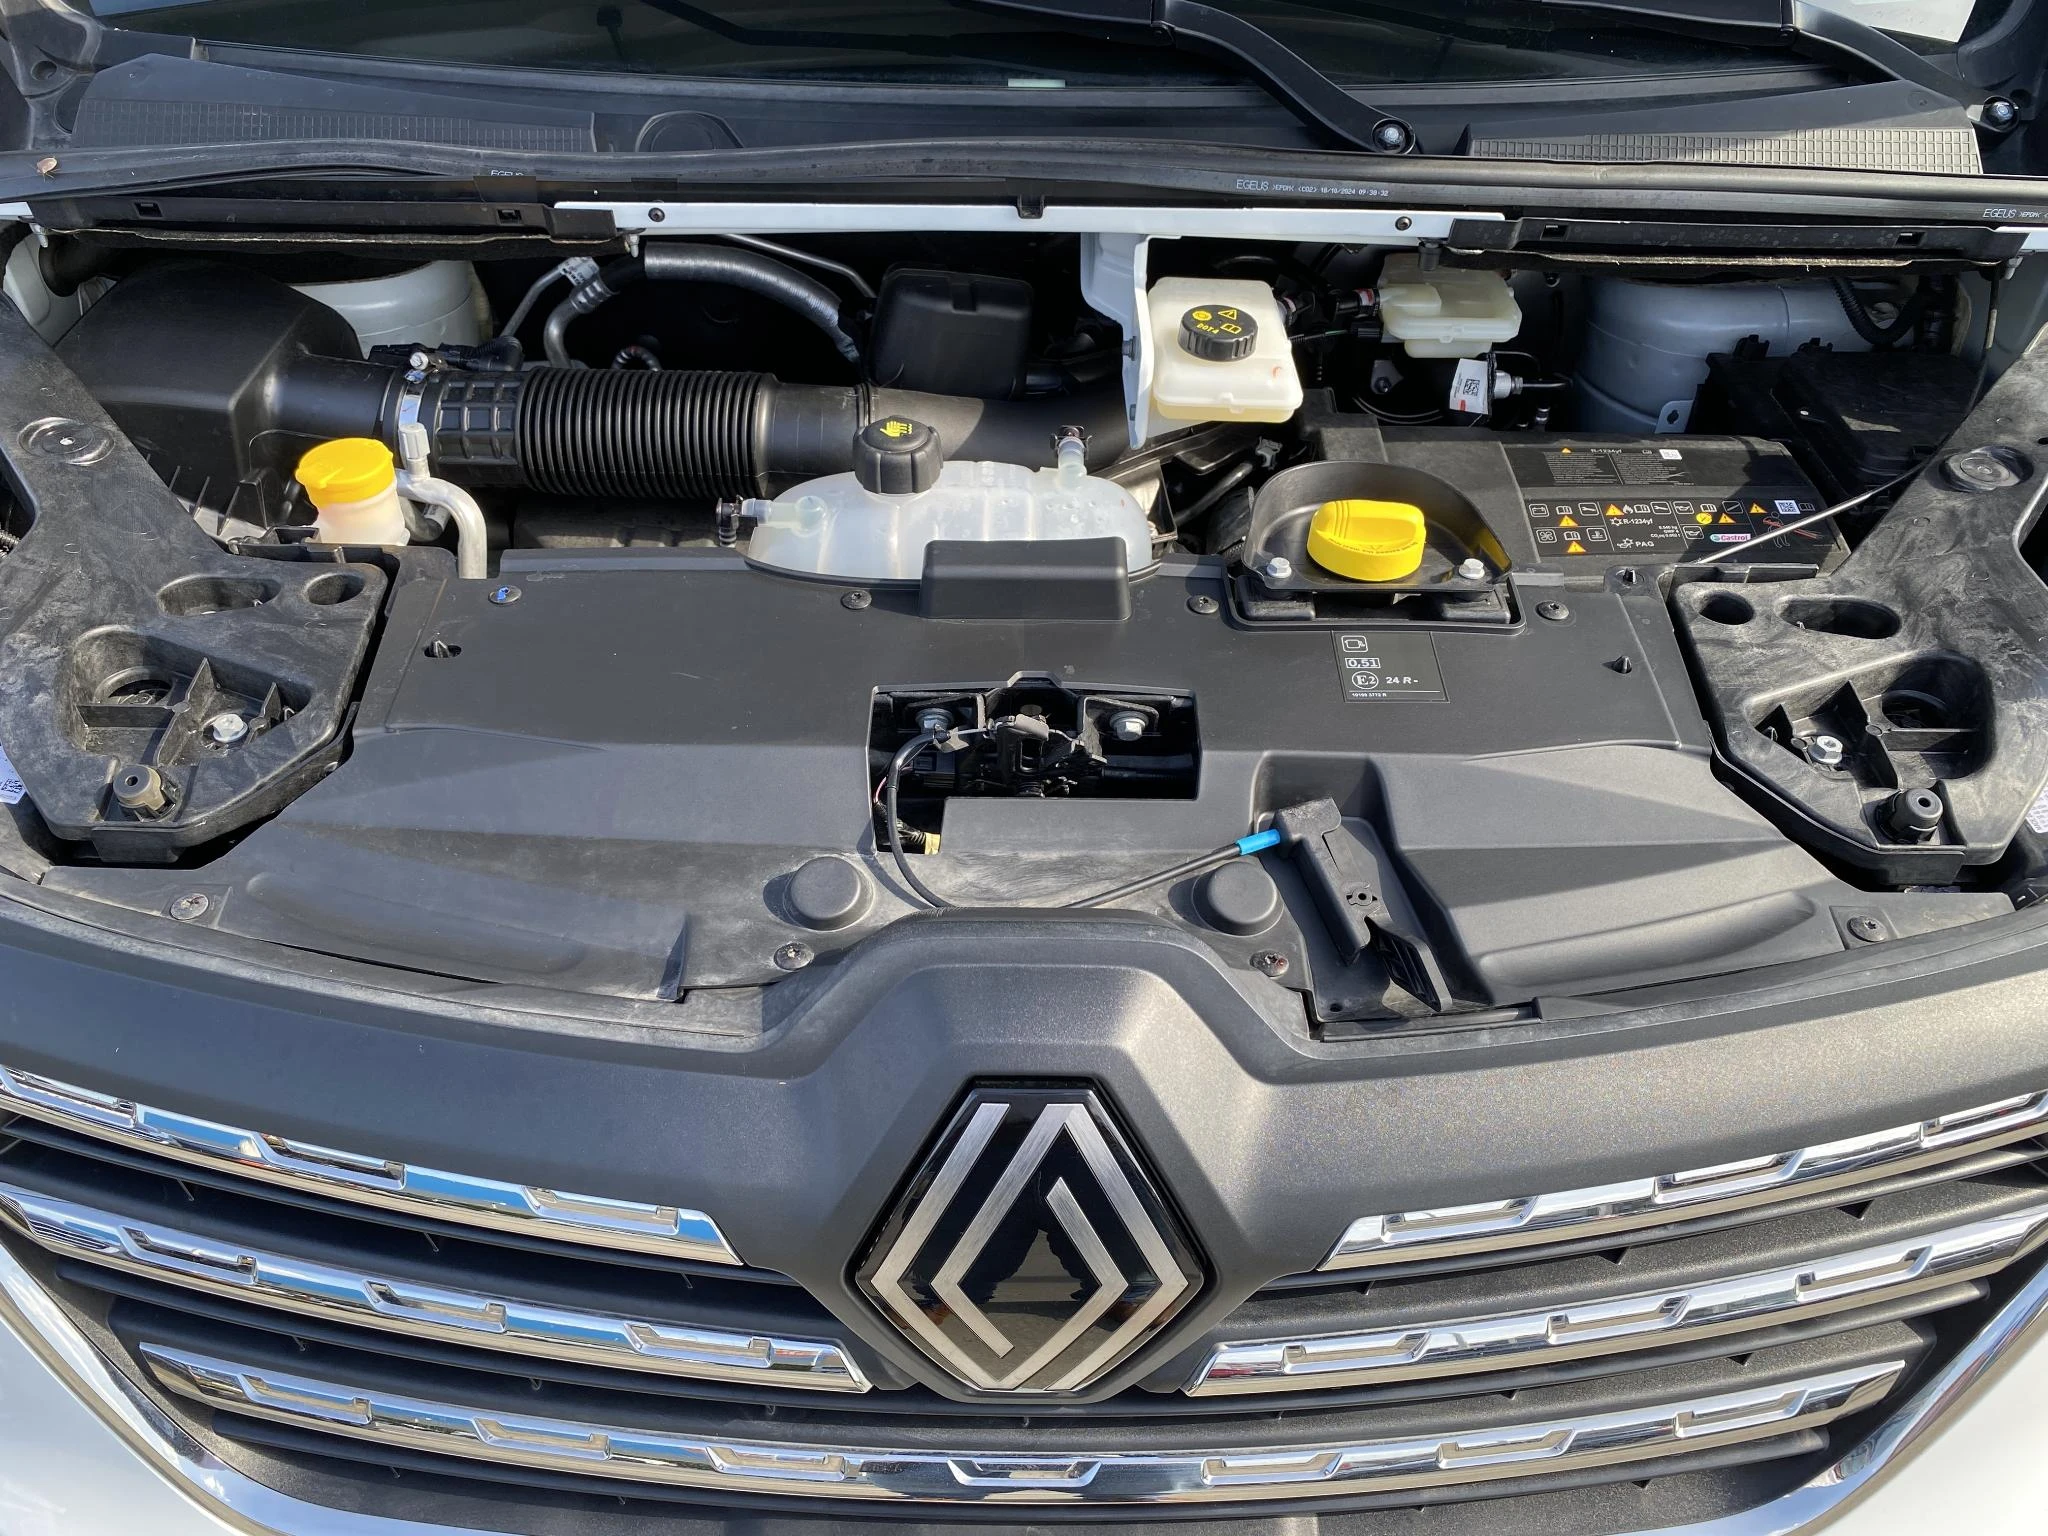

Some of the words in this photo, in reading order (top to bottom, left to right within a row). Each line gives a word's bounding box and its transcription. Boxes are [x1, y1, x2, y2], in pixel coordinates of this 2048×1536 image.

[1235, 179, 1269, 191] EGEUS
[1983, 208, 2017, 219] EGEUS
[1721, 533, 1748, 541] Castrol
[1356, 675, 1376, 685] E2
